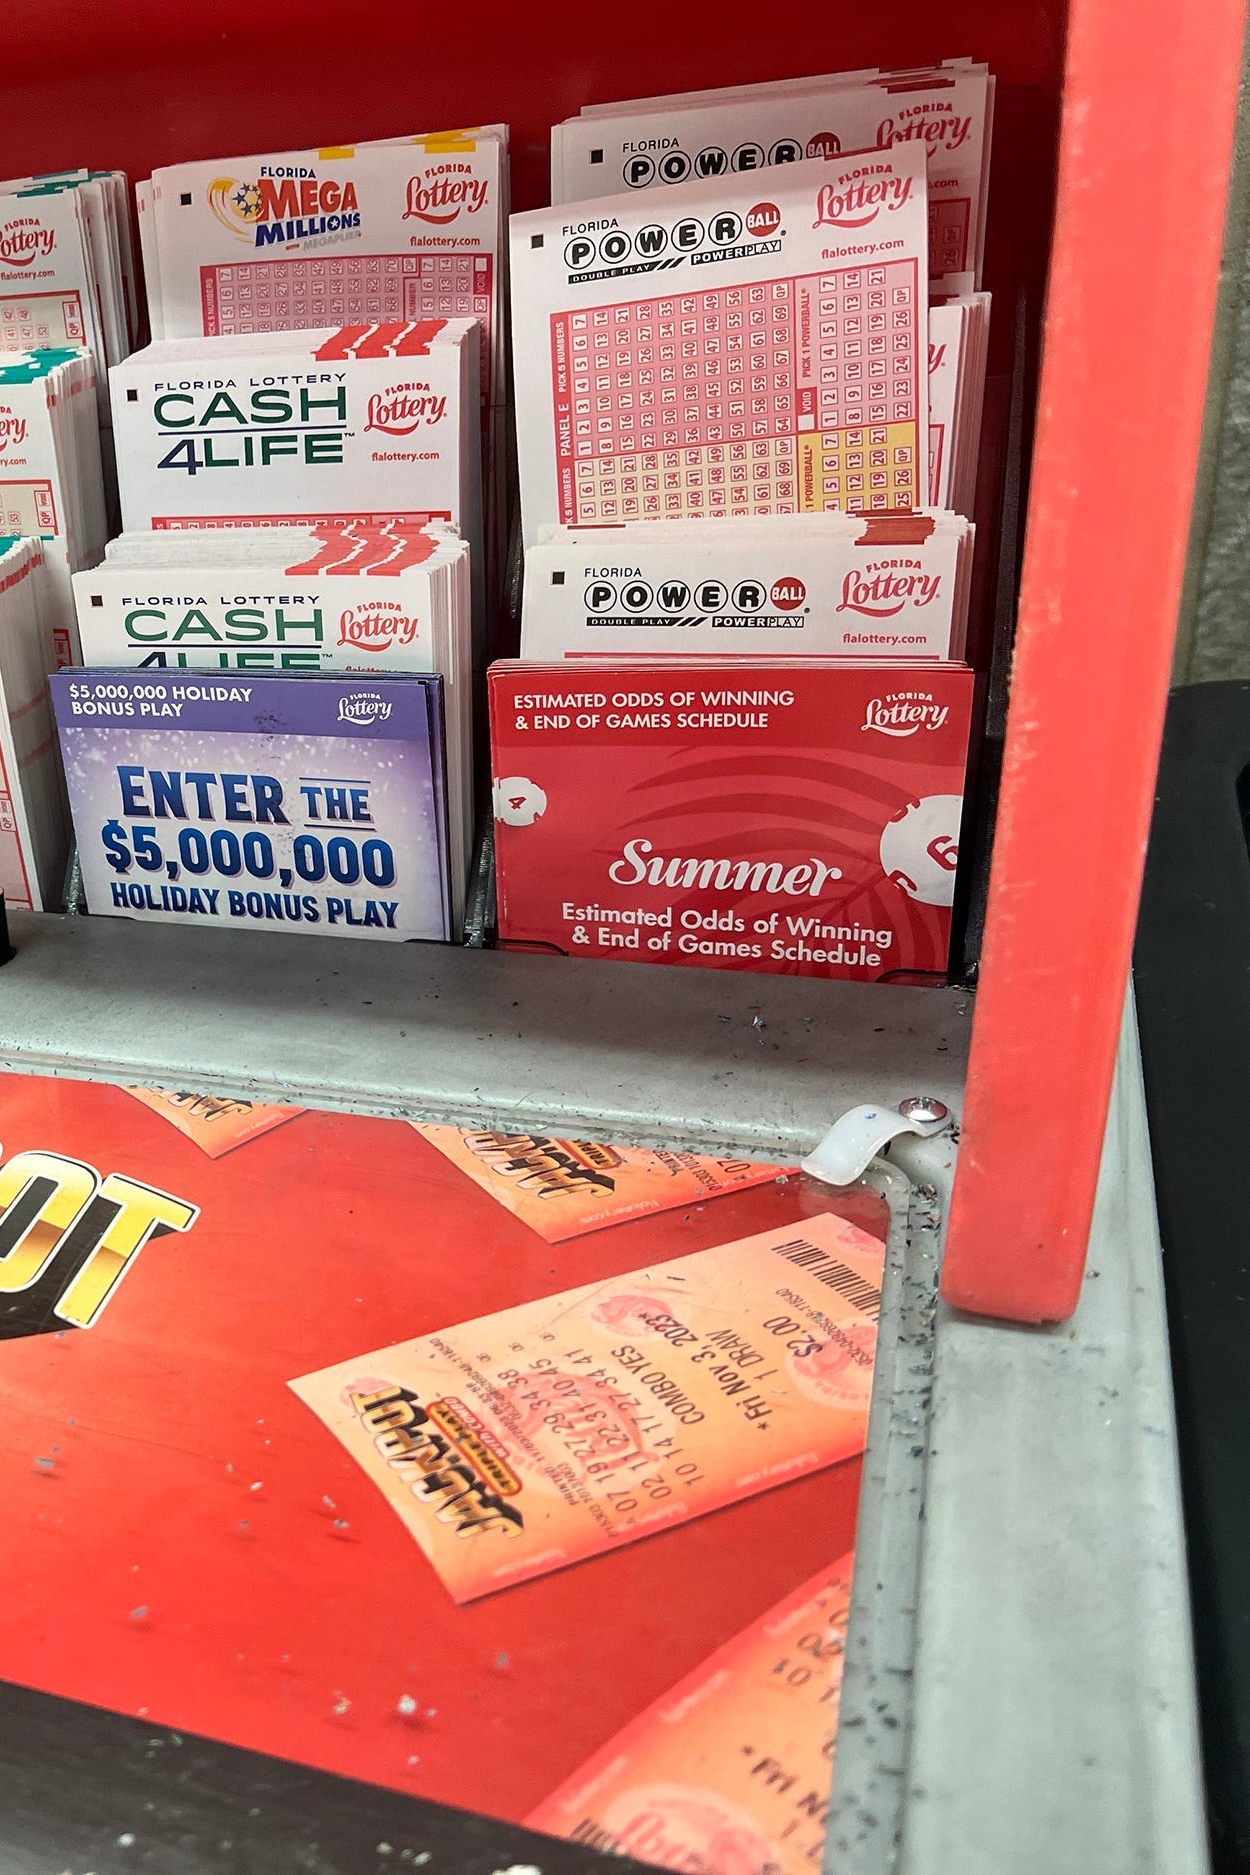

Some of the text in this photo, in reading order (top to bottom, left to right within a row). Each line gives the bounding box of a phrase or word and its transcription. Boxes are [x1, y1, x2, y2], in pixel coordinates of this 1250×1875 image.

[899, 102, 952, 120] FLORIDA
[623, 137, 679, 153] FLORIDA
[261, 167, 316, 179] FLORIDA
[425, 164, 472, 179] FLORIDA
[838, 164, 893, 185] FLORIDA
[257, 179, 358, 222] MEGA
[402, 176, 489, 225] Lottery
[812, 174, 913, 230] Lottery
[5, 218, 40, 230] FLORIDA
[255, 212, 361, 248] MILLIONS
[562, 219, 619, 236] FLORIDA
[410, 236, 480, 248] flalottery.com
[821, 238, 904, 260] flalottery.com
[1, 269, 55, 280] flalottery.com
[572, 264, 650, 282] DOUBLE PLAY
[155, 373, 346, 391] FLORIDA LOTTERY
[385, 382, 430, 397] FLORIDA
[154, 386, 346, 427] CASH
[363, 390, 447, 436] Lottery
[560, 414, 571, 456] PANEL
[157, 433, 344, 475] 4LIFE
[371, 450, 440, 462] flalottery.com
[585, 568, 642, 577] FLORIDA
[866, 559, 922, 574] FLORIDA
[122, 595, 320, 605] FLORIDA LOTTERY
[836, 570, 940, 618] Lottery
[356, 602, 402, 613] FLORIDA
[124, 609, 323, 642] CASH
[337, 609, 418, 653] Lottery
[591, 618, 636, 626] DOUBLE
[843, 634, 927, 645] flalottery.com
[70, 684, 252, 702] $5,000,000 HOLIDAY
[514, 690, 794, 709] ESTIMATED ODDS OF WINNING
[886, 693, 932, 702] FLORIDA
[72, 702, 183, 717] BONUS PLAY
[337, 698, 392, 725] Lottery
[862, 700, 949, 736] Lottery
[515, 713, 768, 729] & END OF GAMES SCHEDULE
[116, 765, 371, 825] ENTER THE
[101, 820, 397, 888] $5,000,000
[609, 839, 842, 896] Summer
[110, 882, 399, 928] HOLIDAY BONUS PLAY
[562, 903, 893, 948] Estimated Odds of Winning
[571, 926, 881, 967] & End of Games Schedule
[762, 1316, 824, 1358] $2.00
[706, 1329, 765, 1369] DRAW
[611, 1346, 705, 1425] COMBO YES
[709, 1364, 750, 1396] Nov
[350, 1386, 524, 1539] JACKPOT
